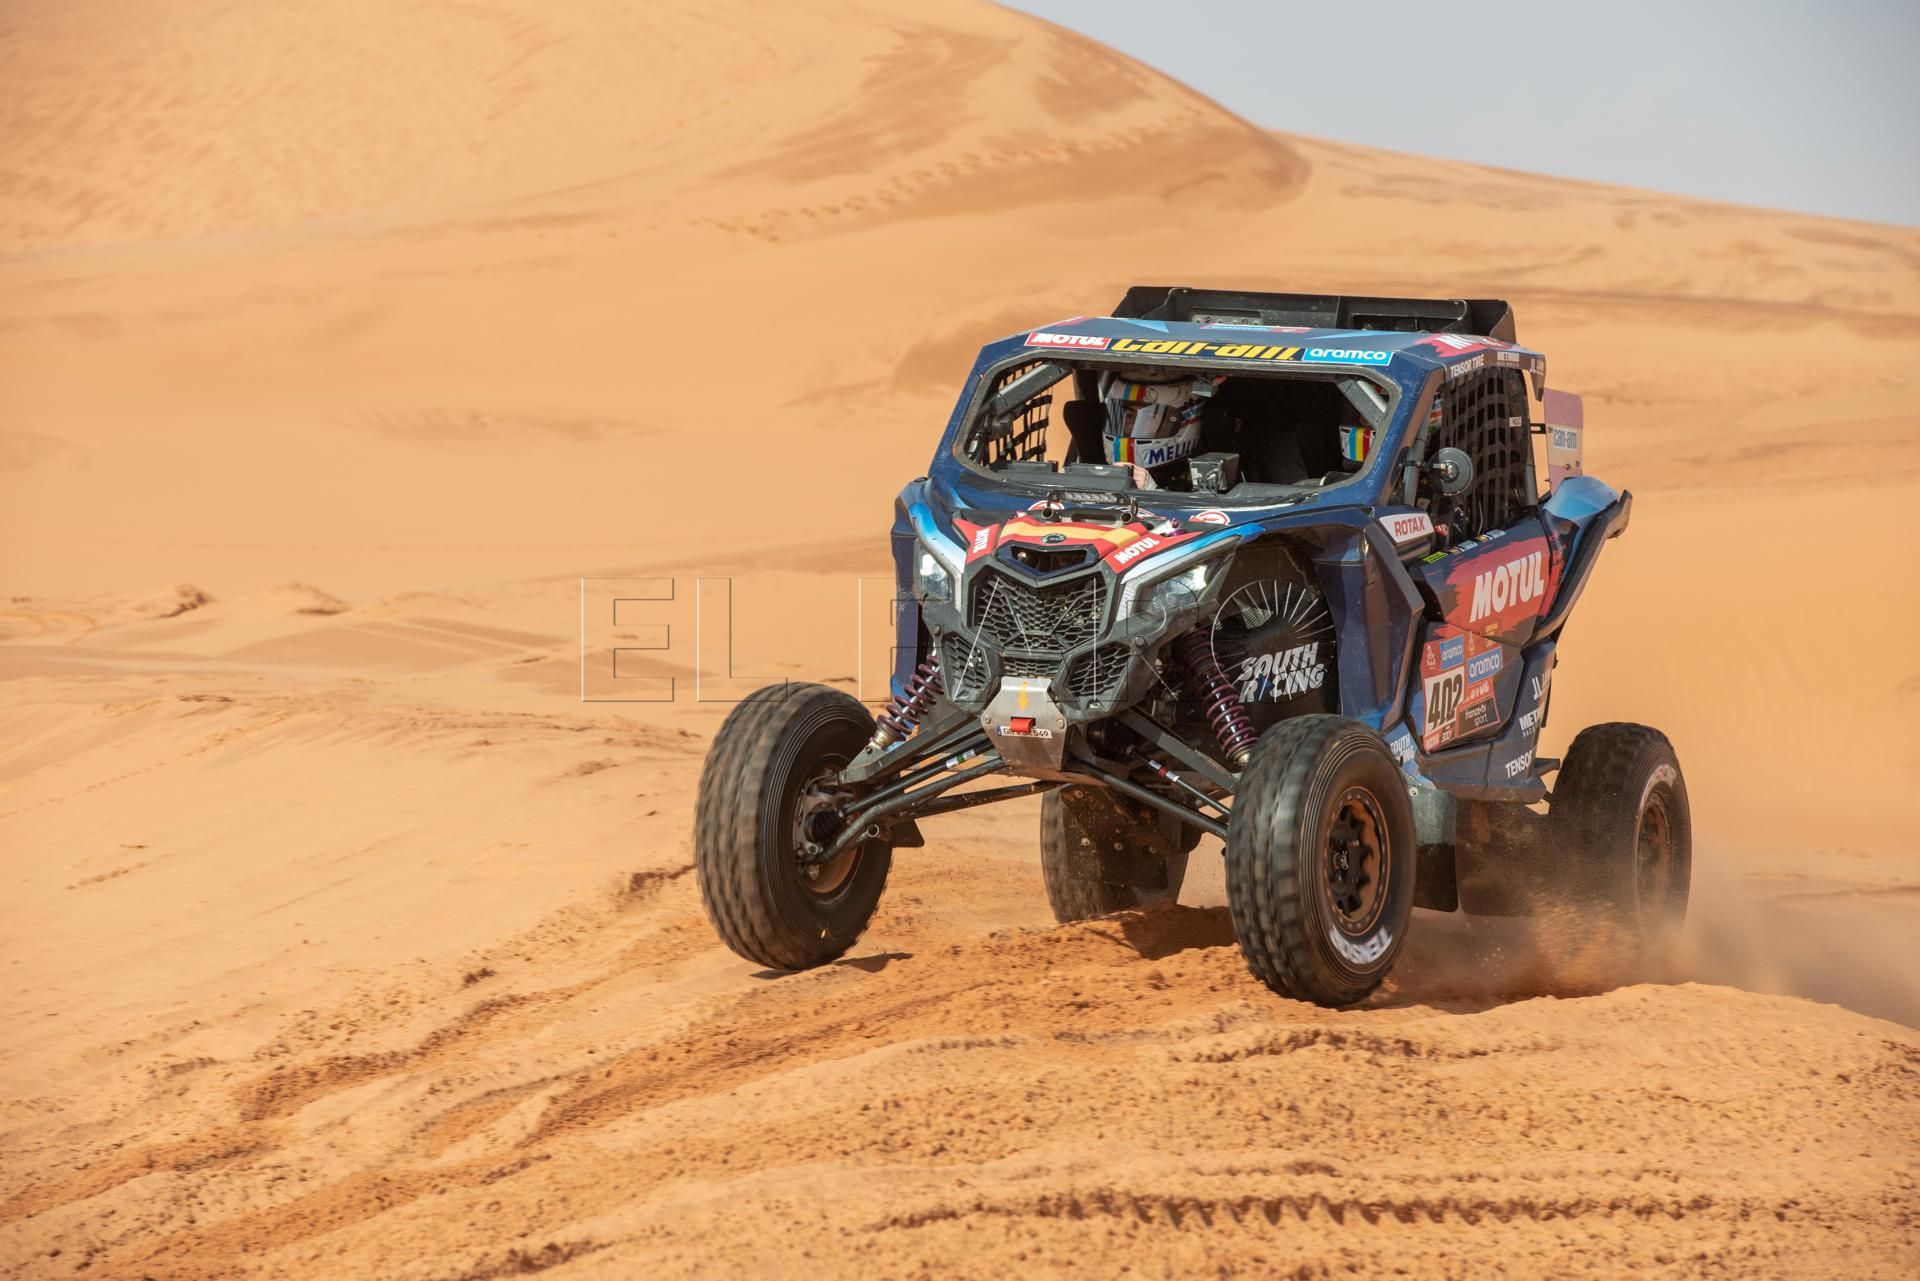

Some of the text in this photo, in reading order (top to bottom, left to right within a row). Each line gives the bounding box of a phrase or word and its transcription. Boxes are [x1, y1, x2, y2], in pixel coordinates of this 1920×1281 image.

[1031, 333, 1106, 346] MOTUL
[1309, 348, 1387, 361] aramco
[1450, 353, 1485, 378] TENSOR TIRE
[1394, 516, 1425, 537] ROTAX
[1113, 537, 1161, 565] MOTUL
[1469, 551, 1545, 624] MOTUL
[1239, 641, 1319, 681] SOUTH
[1442, 645, 1463, 661] aramco
[1469, 653, 1500, 678] aramco
[1427, 673, 1463, 733] 402
[1474, 713, 1488, 728] sport
